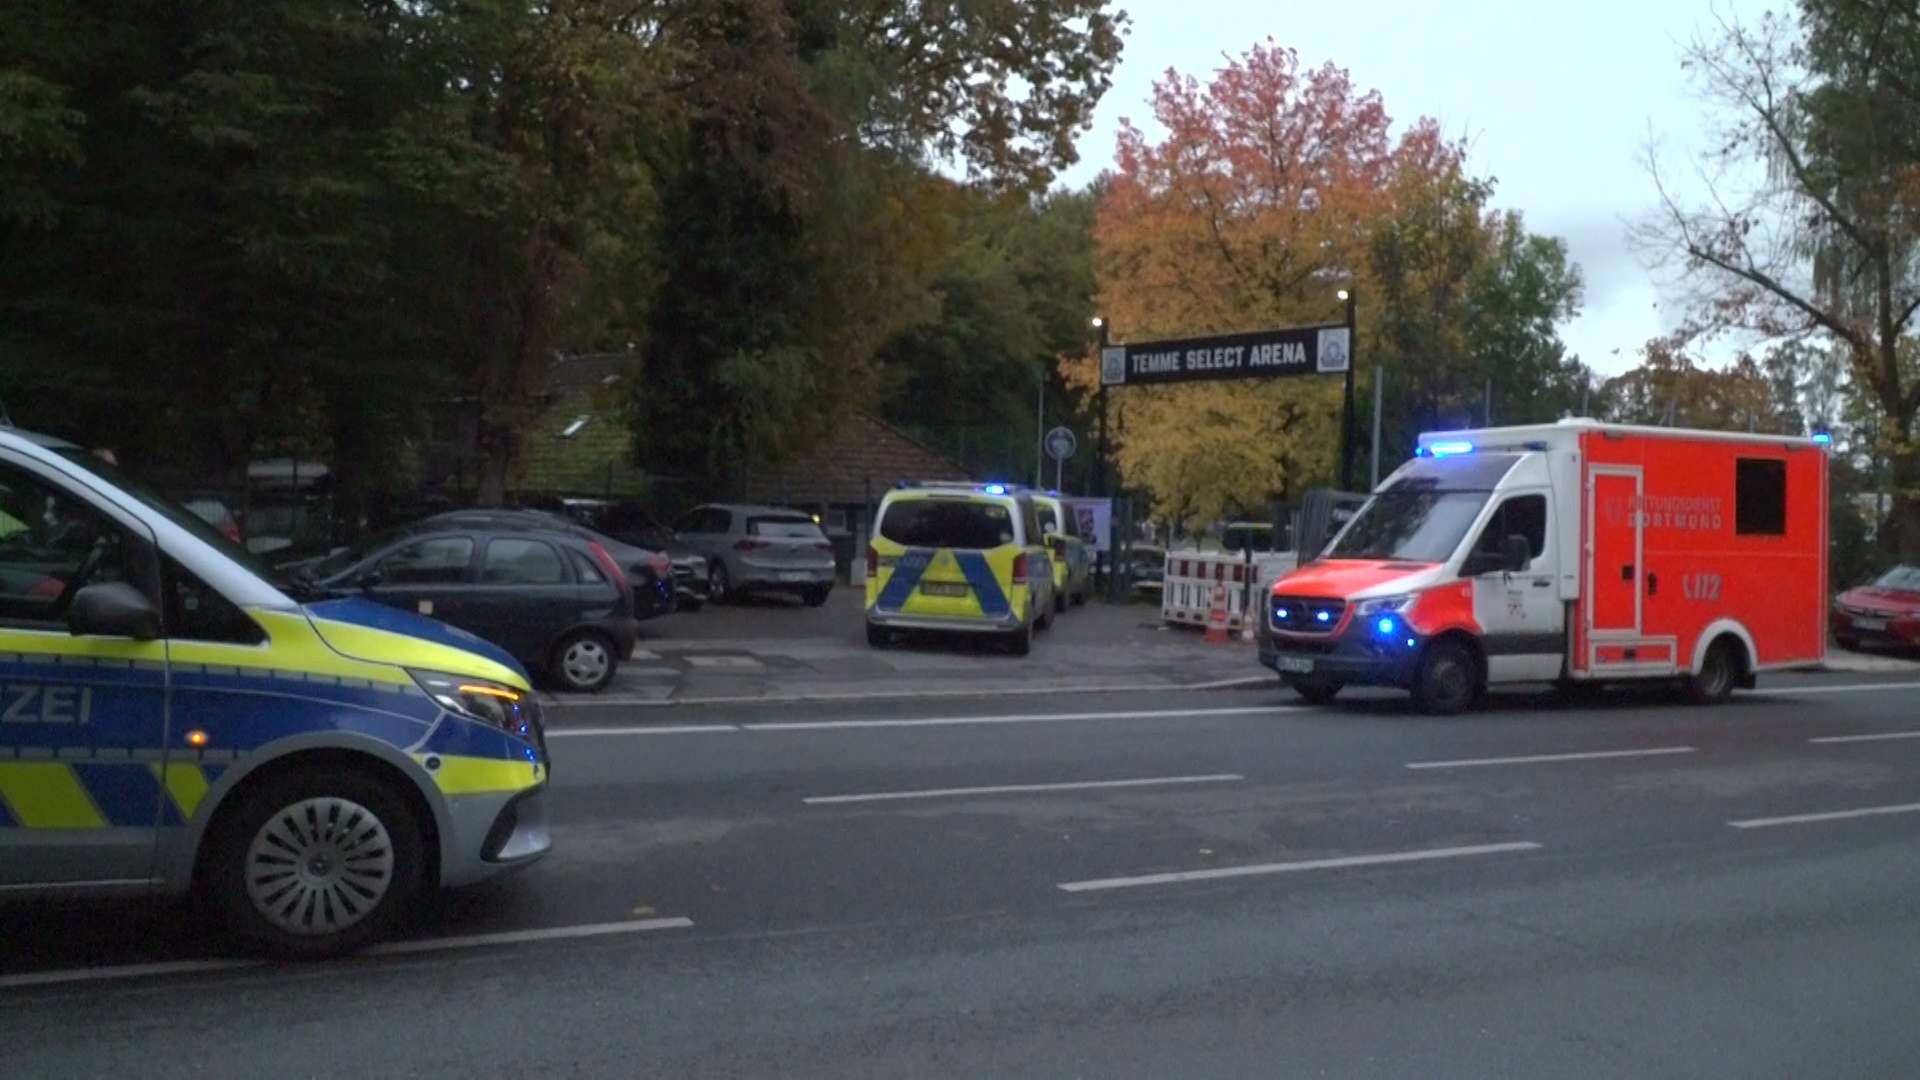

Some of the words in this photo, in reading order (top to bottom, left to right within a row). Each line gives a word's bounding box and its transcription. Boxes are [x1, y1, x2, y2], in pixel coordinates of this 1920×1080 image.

[1132, 353, 1181, 373] TEMME
[1187, 347, 1244, 370] SELECT
[1250, 343, 1306, 366] ARENA
